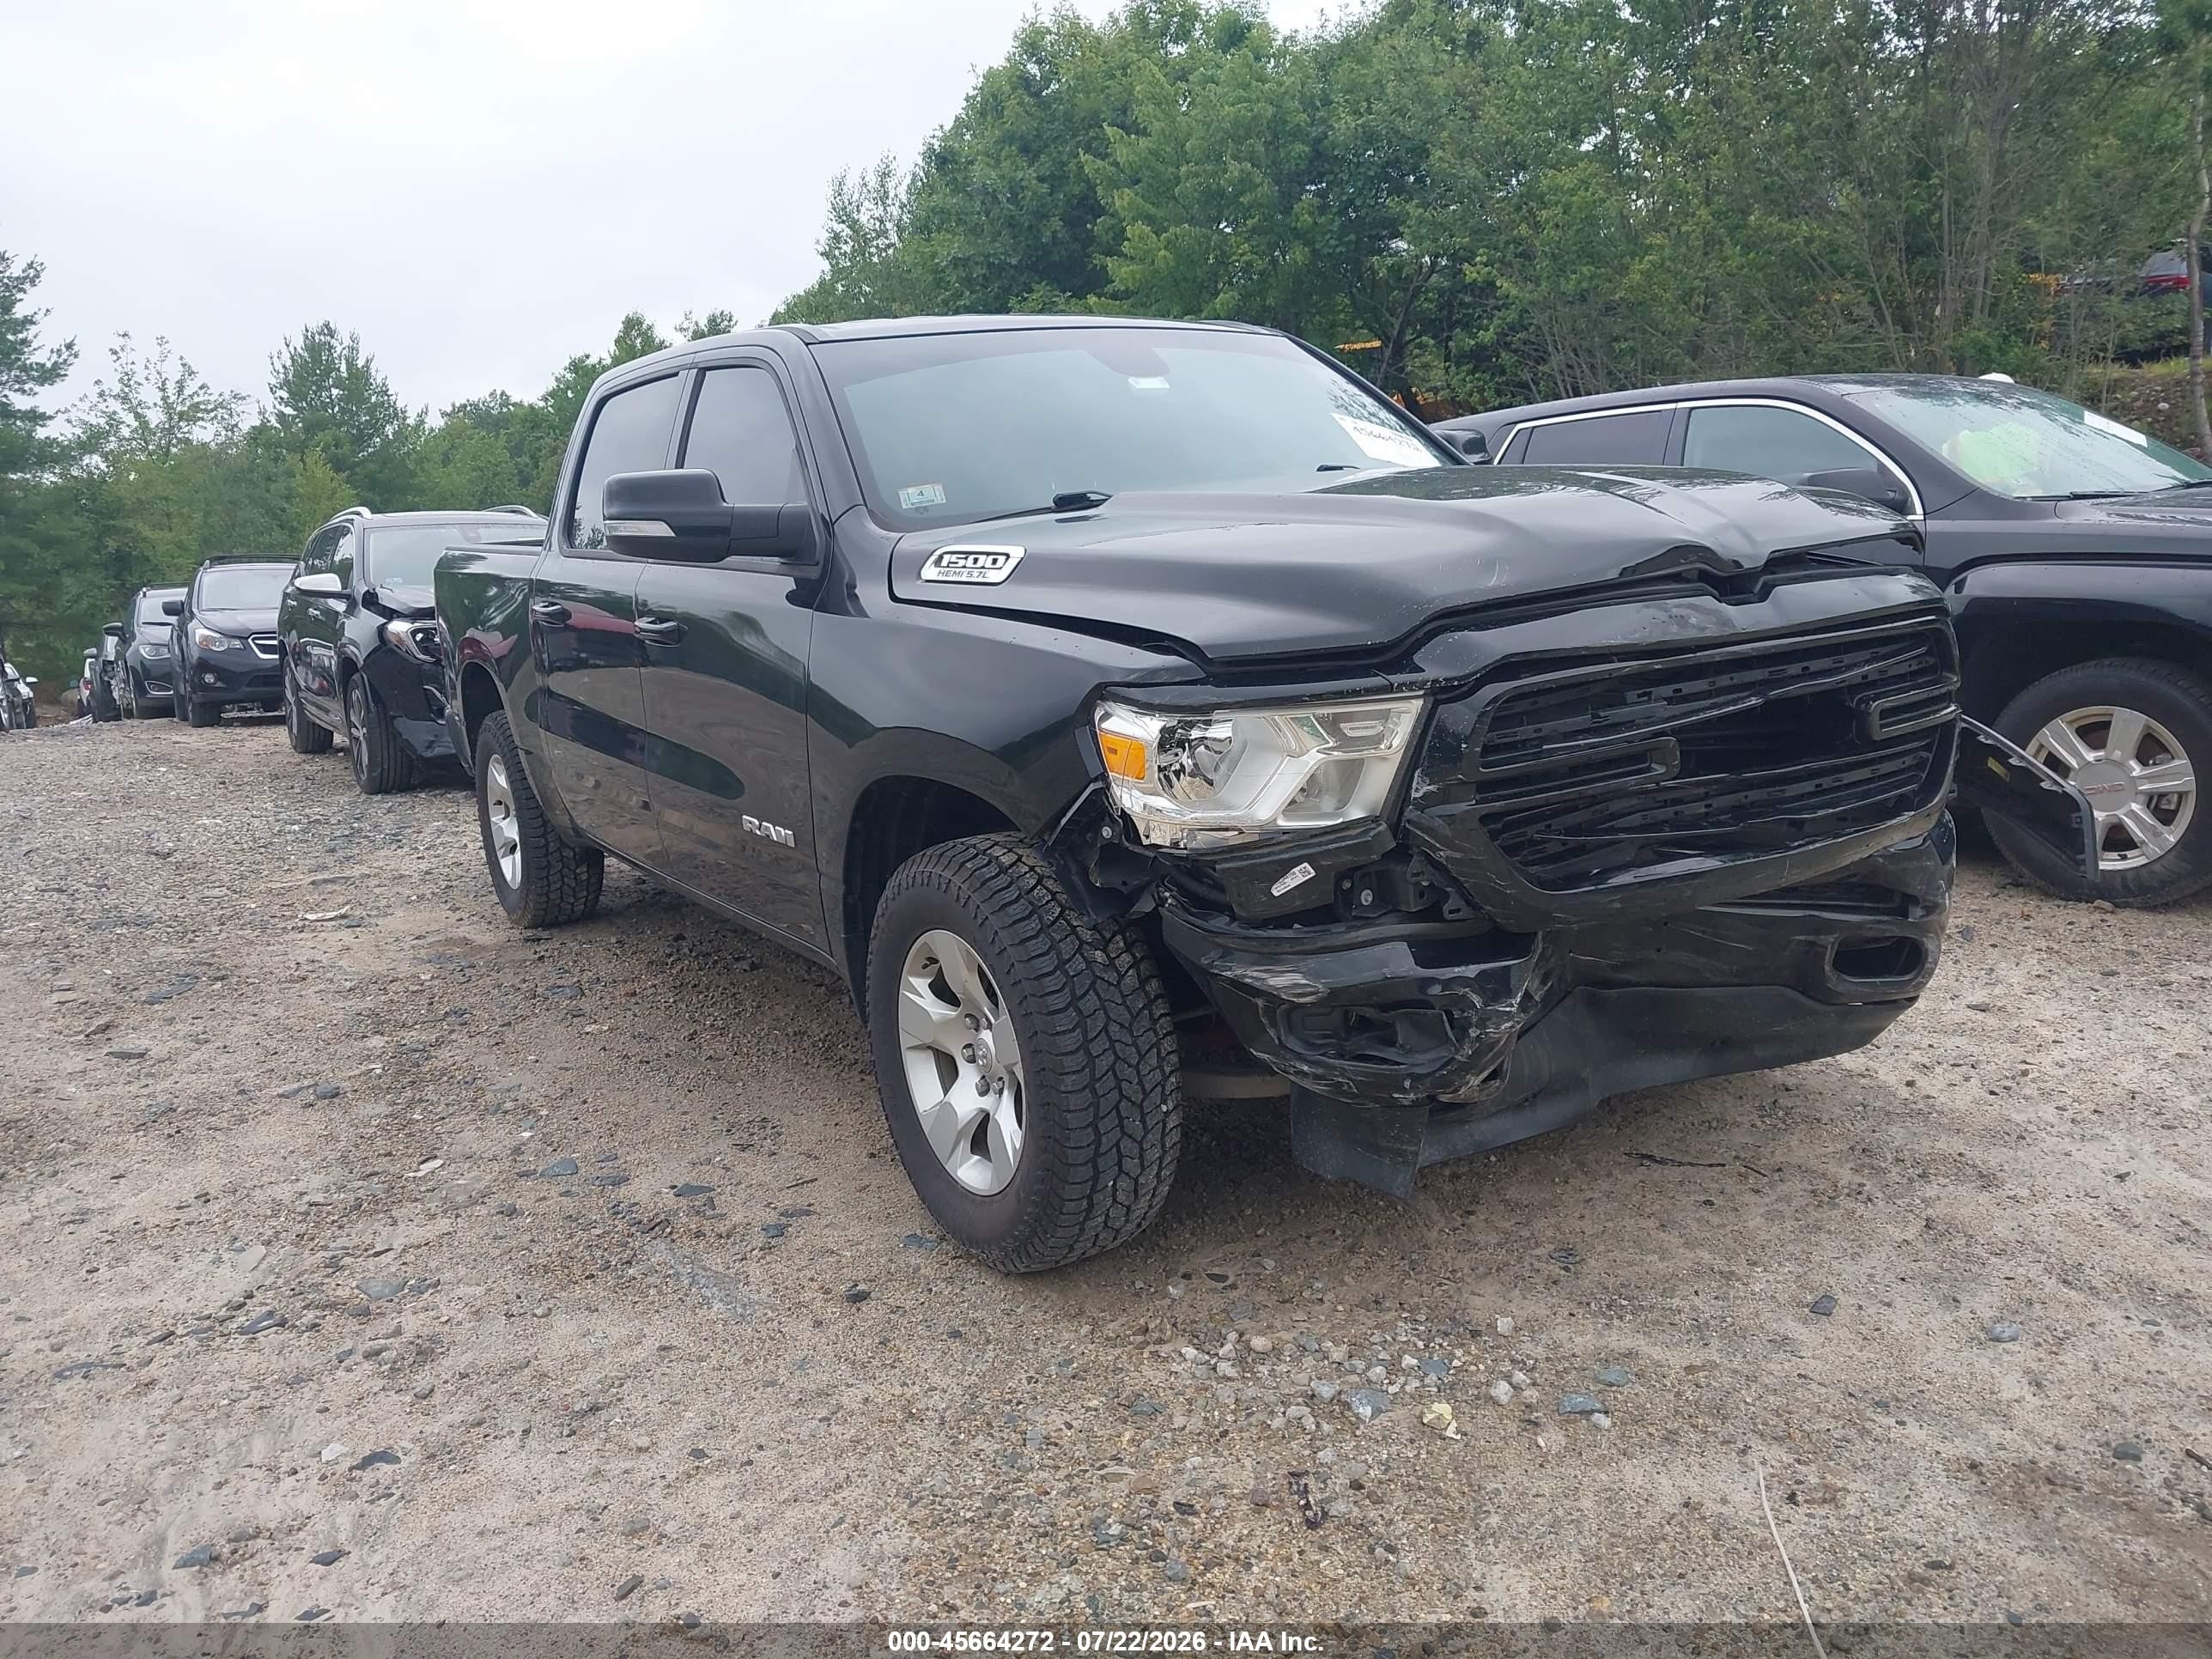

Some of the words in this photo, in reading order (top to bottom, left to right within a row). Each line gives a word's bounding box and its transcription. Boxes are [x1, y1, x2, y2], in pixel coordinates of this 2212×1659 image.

[939, 553, 1008, 568] 1500
[965, 570, 990, 579] 5.7L
[742, 815, 795, 848] RAM
